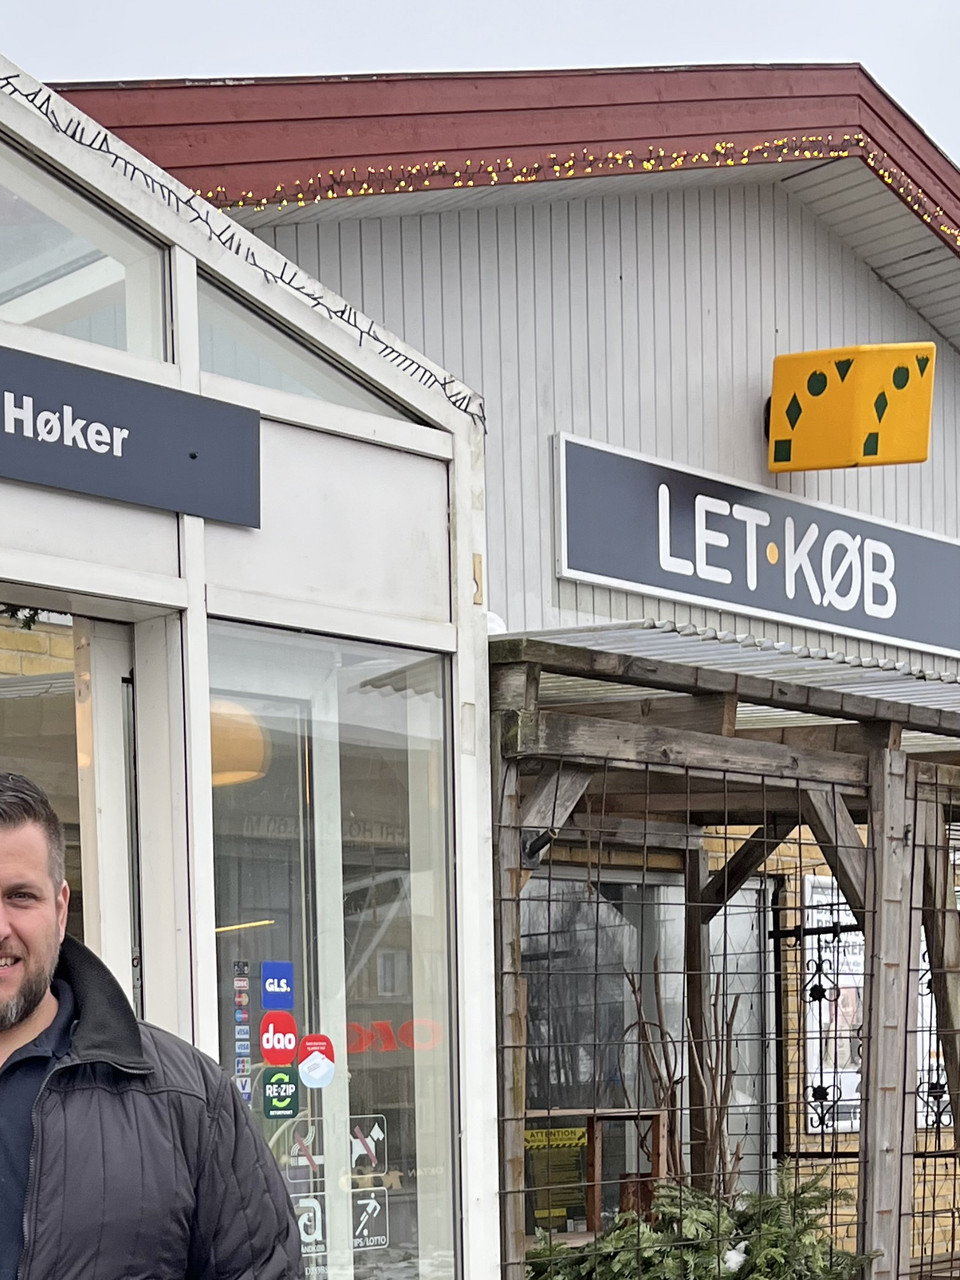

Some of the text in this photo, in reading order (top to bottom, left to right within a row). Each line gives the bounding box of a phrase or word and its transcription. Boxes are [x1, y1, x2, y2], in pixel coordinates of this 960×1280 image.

[3, 391, 130, 457] Høker
[262, 1023, 296, 1050] dao
[530, 1129, 577, 1139] ATTENTION
